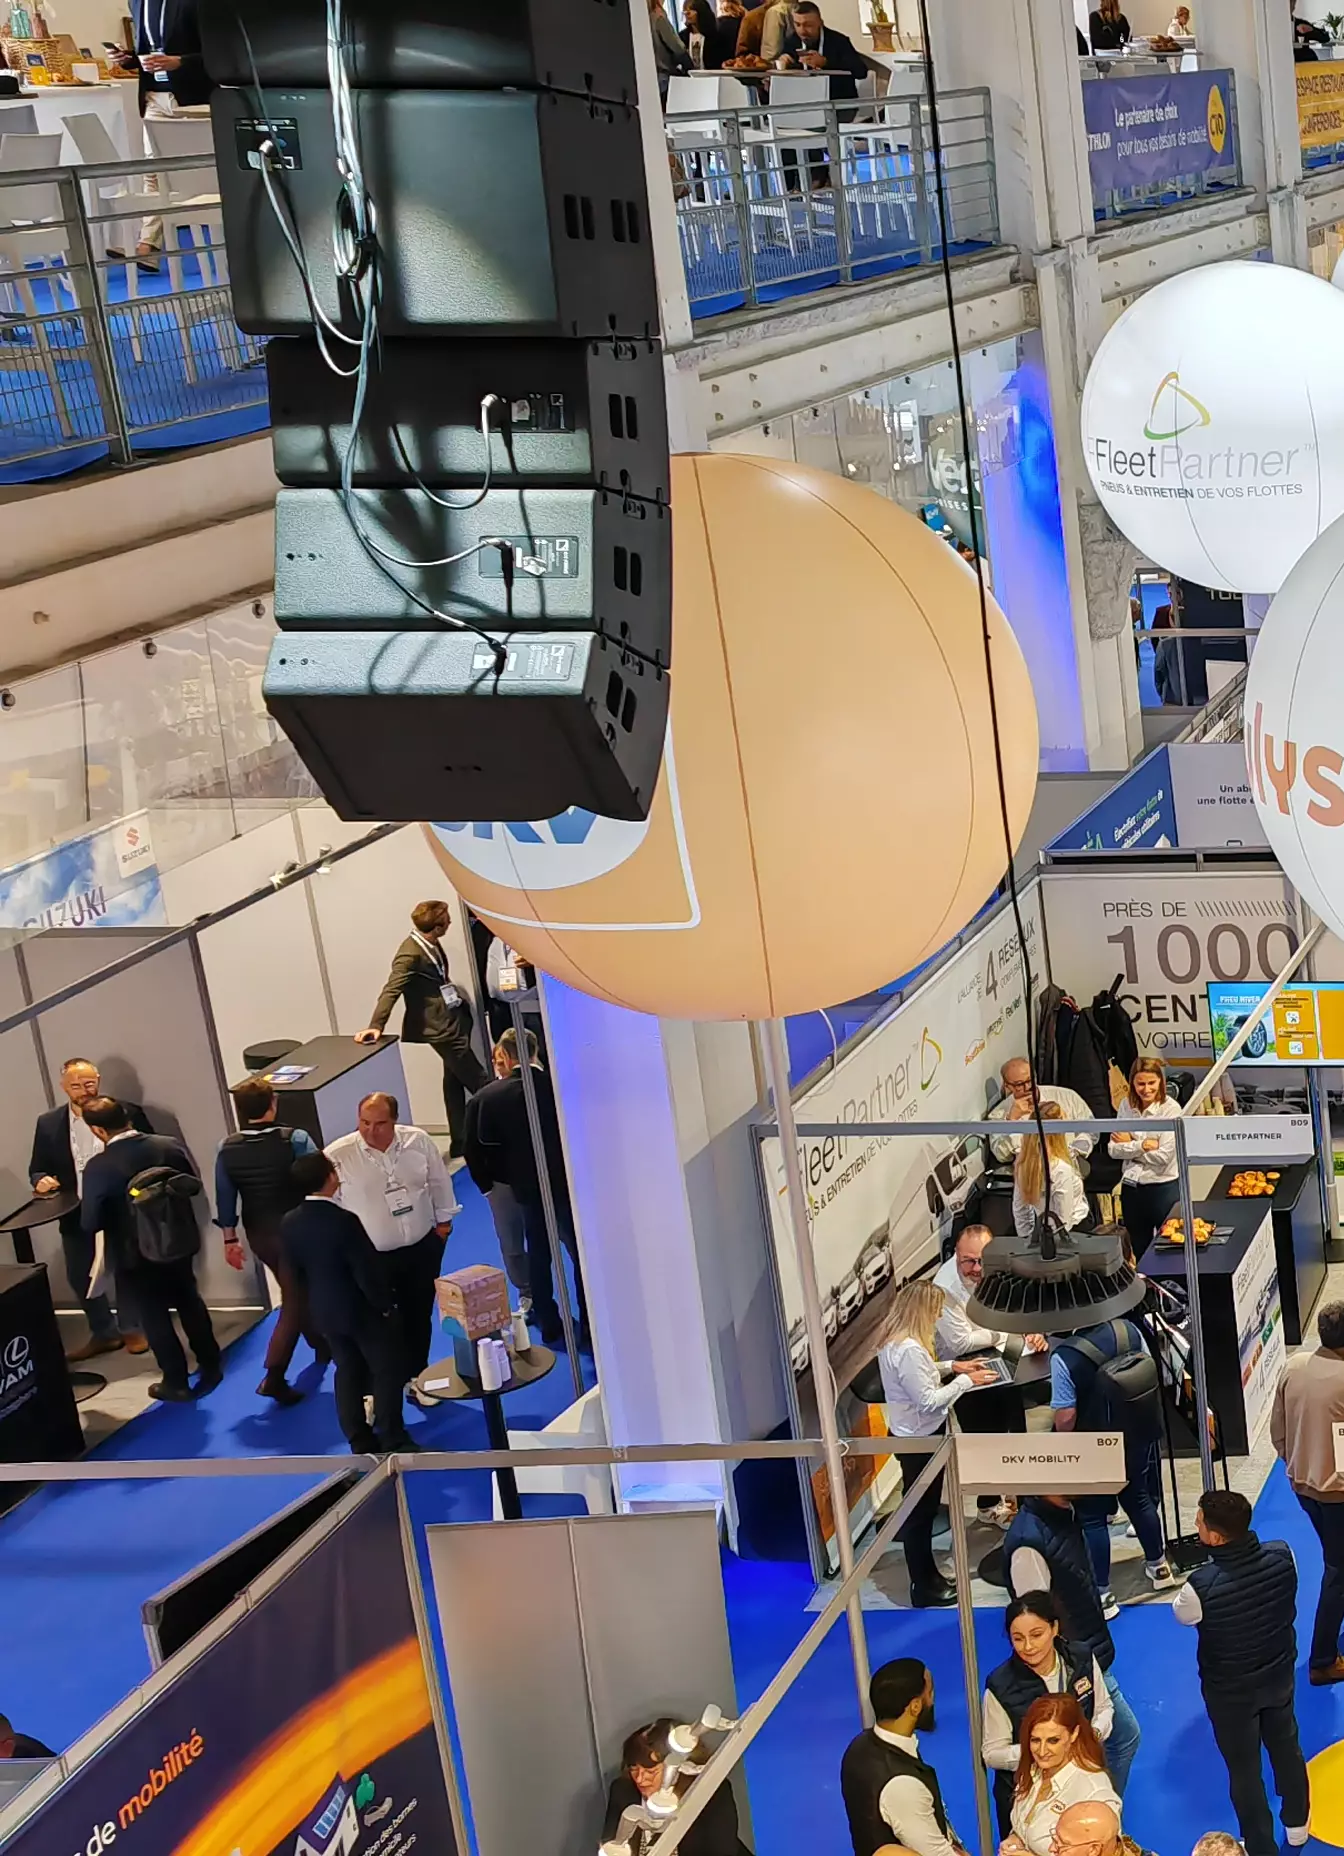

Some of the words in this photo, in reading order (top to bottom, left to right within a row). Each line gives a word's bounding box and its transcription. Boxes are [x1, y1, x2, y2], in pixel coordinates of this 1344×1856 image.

[1115, 108, 1124, 127] Le
[1125, 104, 1154, 132] partenaire
[1155, 104, 1164, 121] de
[1087, 132, 1111, 151] THLON
[1178, 129, 1187, 146] de
[1095, 436, 1299, 480] FleetPartner
[1100, 480, 1125, 494] PNEUS
[1126, 483, 1132, 495] &
[1134, 486, 1194, 499] ENTRETIEN
[1197, 488, 1215, 499] DE
[1216, 486, 1244, 498] VOS
[1247, 484, 1302, 497] FLOTTES
[1220, 785, 1233, 793] Un
[1220, 796, 1246, 805] flotte
[1103, 899, 1153, 918] PRÈS
[1162, 902, 1187, 917] DE
[998, 917, 1036, 969] RÉSEUX
[1107, 923, 1299, 985] 1000
[986, 950, 998, 1001] 4
[1137, 1032, 1211, 1049] VOTRE
[798, 1054, 911, 1187] leetPartner
[1216, 1133, 1282, 1141] FLEETPARTNER
[1097, 1437, 1119, 1447] B07
[1002, 1455, 1025, 1464] DKV
[1028, 1453, 1081, 1464] MOBILITY
[118, 1727, 205, 1831] mobilité
[87, 1819, 117, 1856] de
